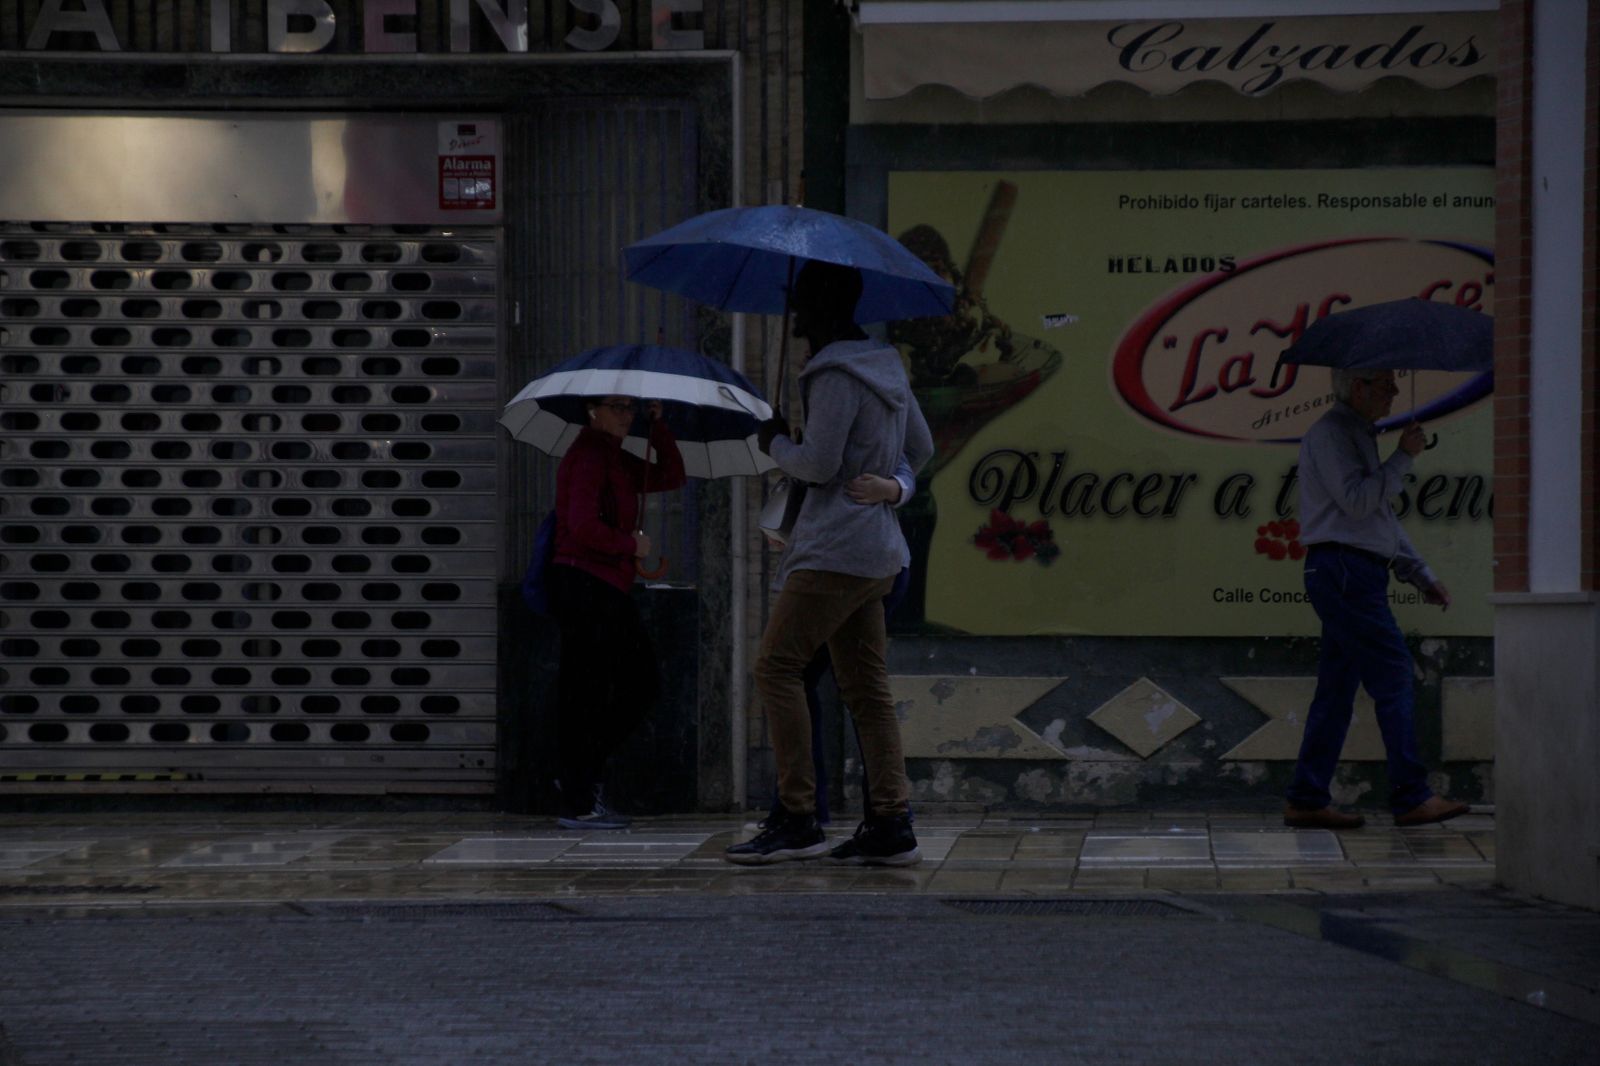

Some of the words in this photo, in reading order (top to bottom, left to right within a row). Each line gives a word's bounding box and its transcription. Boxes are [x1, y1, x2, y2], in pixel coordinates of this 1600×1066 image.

[1107, 21, 1486, 94] Calzados
[443, 158, 491, 170] Alarma
[1119, 195, 1199, 210] Prohibido
[1204, 194, 1236, 212] fijar
[1241, 194, 1312, 209] carteles.
[1318, 193, 1427, 211] Responsable
[1433, 193, 1447, 208] el
[1452, 195, 1496, 208] anun
[1108, 255, 1236, 273] HELADOS
[1252, 393, 1337, 429] Artesan
[969, 449, 1198, 519] Placer
[1214, 473, 1256, 519] a
[1397, 473, 1495, 520] sen
[1213, 588, 1254, 602] Calle
[1259, 588, 1312, 603] Conce
[1384, 588, 1426, 604] Huel
